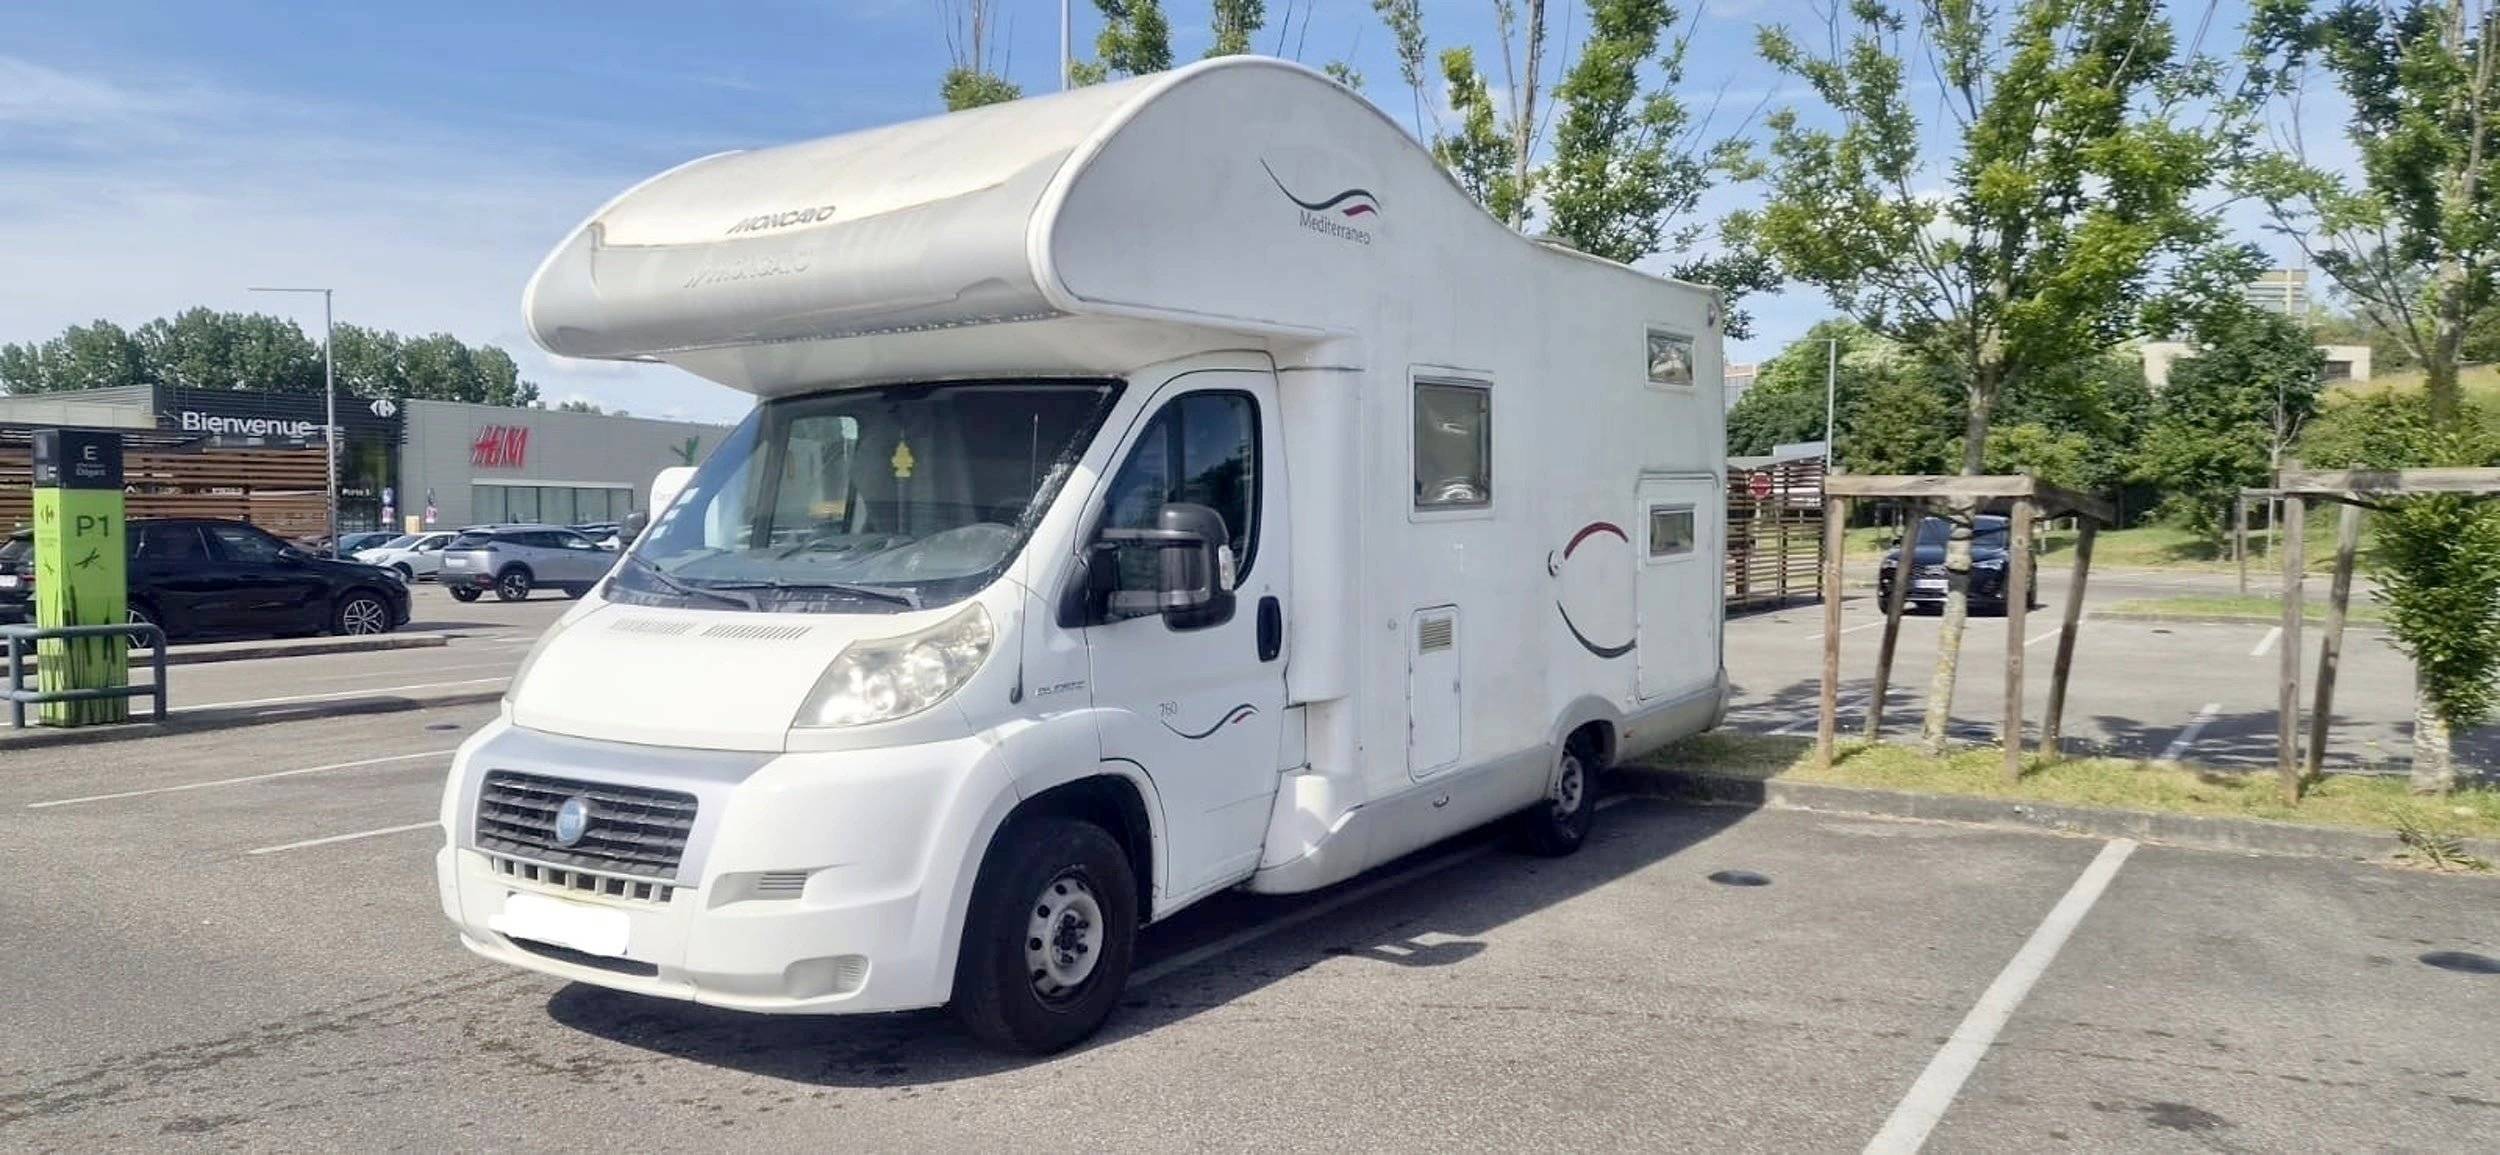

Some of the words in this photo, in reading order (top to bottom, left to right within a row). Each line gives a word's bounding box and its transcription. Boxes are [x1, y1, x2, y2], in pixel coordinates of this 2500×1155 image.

[1299, 208, 1371, 246] Mediterraneo
[181, 411, 313, 436] Bienvenue
[84, 445, 98, 461] E
[76, 514, 109, 537] P1
